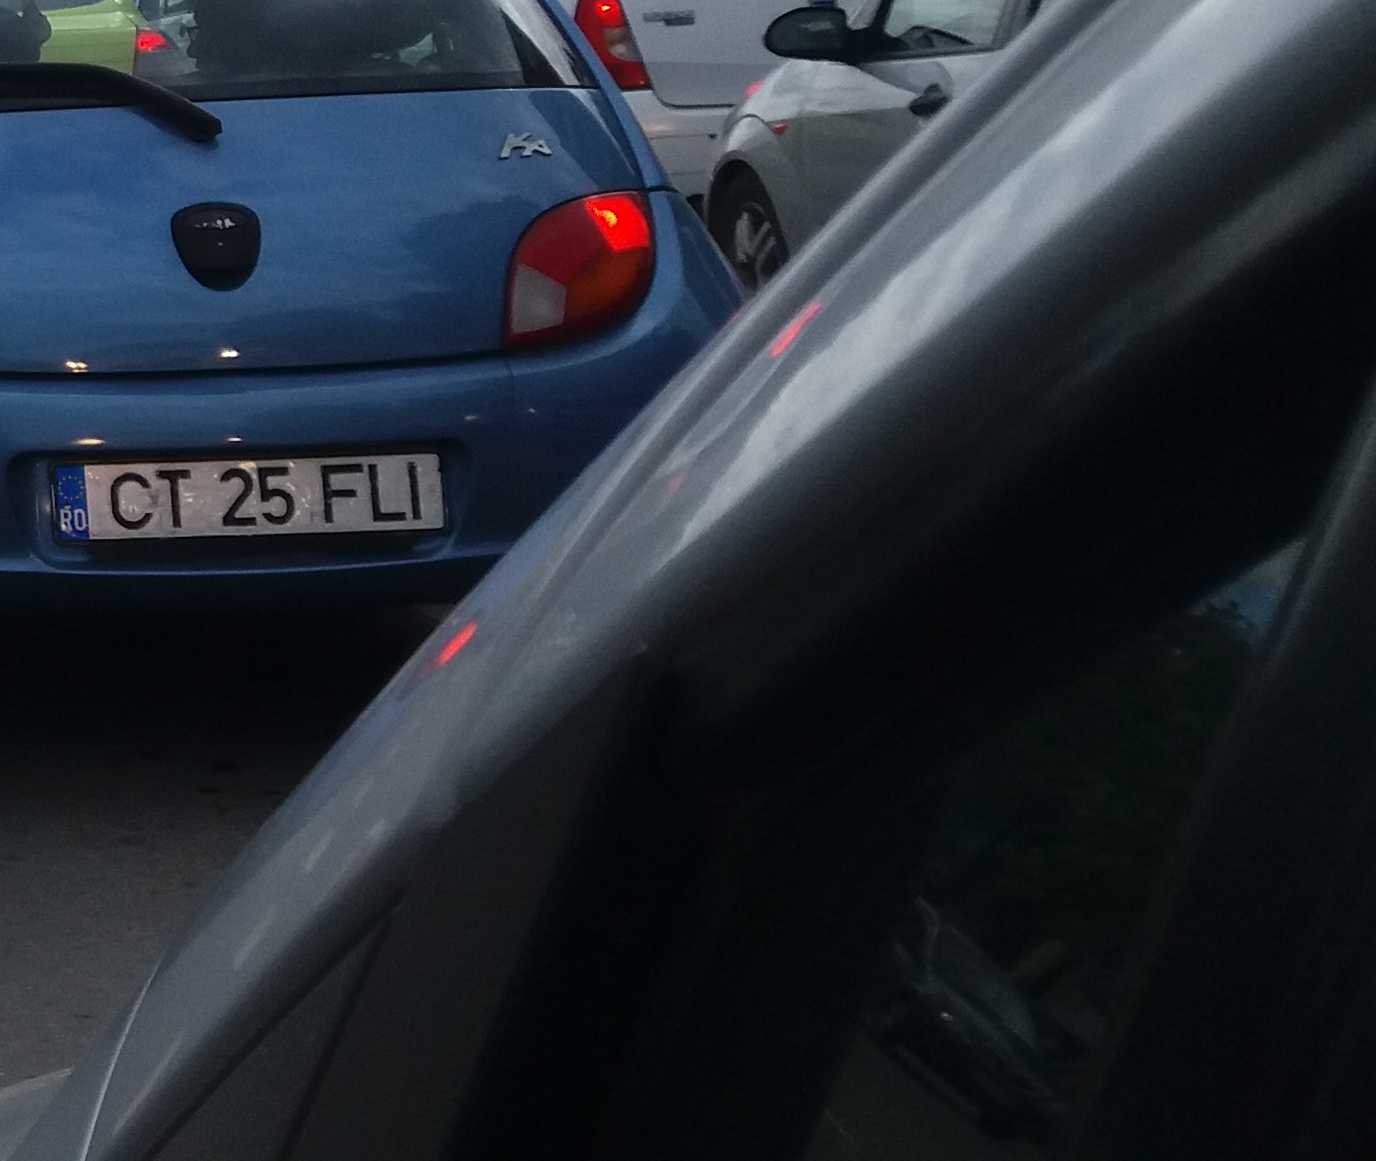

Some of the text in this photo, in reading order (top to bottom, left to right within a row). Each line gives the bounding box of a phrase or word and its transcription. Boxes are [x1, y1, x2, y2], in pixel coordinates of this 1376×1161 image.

[110, 461, 423, 531] CT 25 FLI
[59, 508, 88, 533] RO
